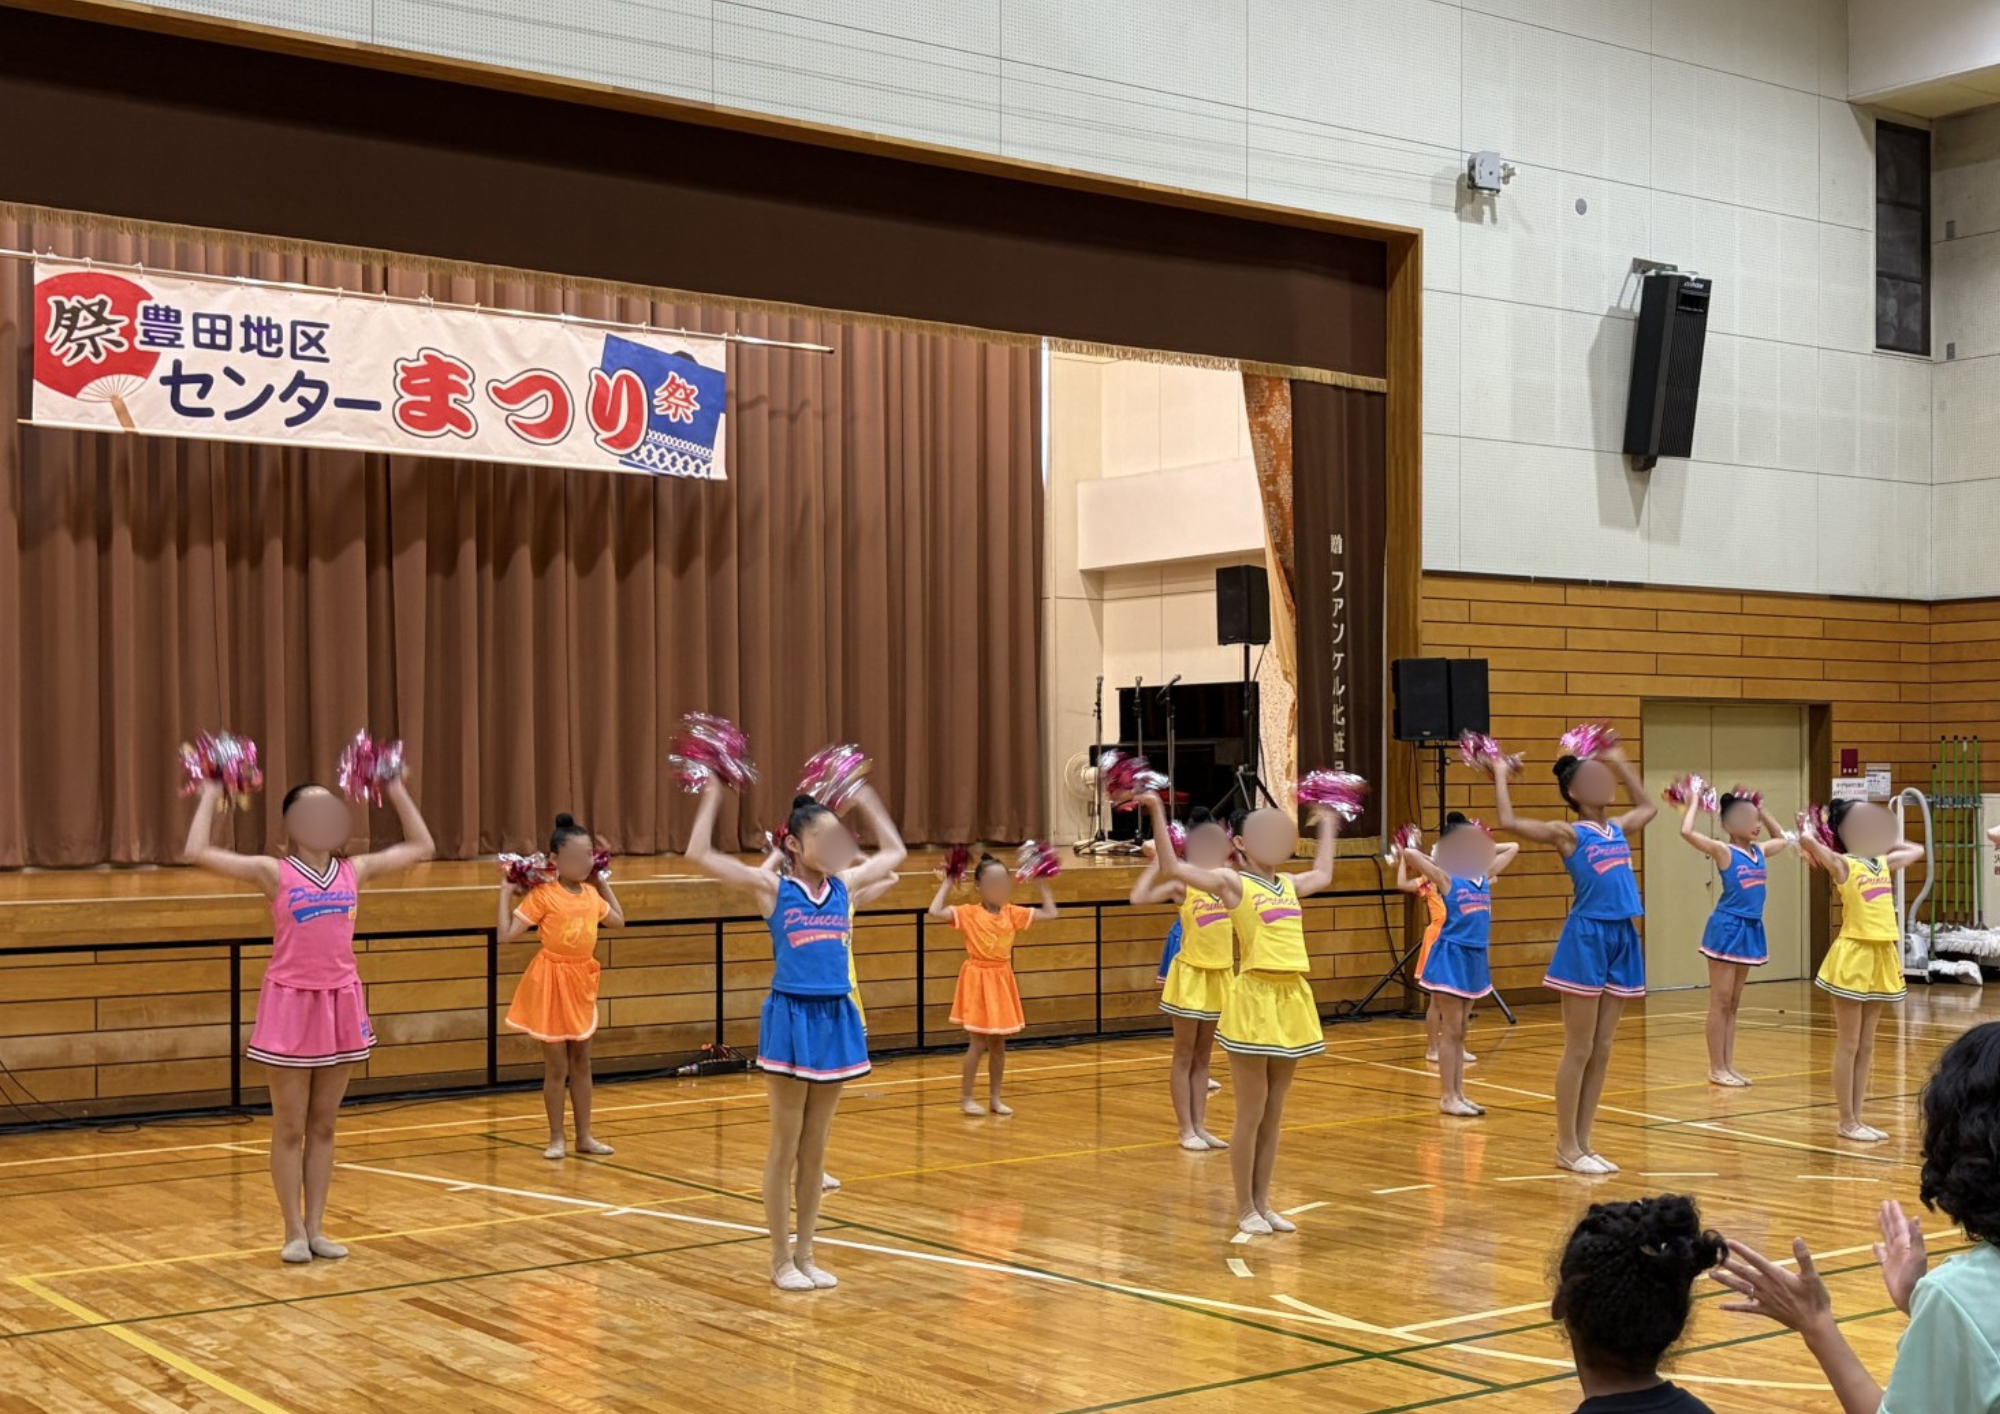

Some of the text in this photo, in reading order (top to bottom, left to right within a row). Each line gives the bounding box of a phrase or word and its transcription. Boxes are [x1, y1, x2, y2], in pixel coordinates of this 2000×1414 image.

[47, 297, 128, 363] 祭
[139, 303, 330, 363] 豊田地区
[159, 350, 648, 453] センター まつり
[655, 371, 699, 423] 祭
